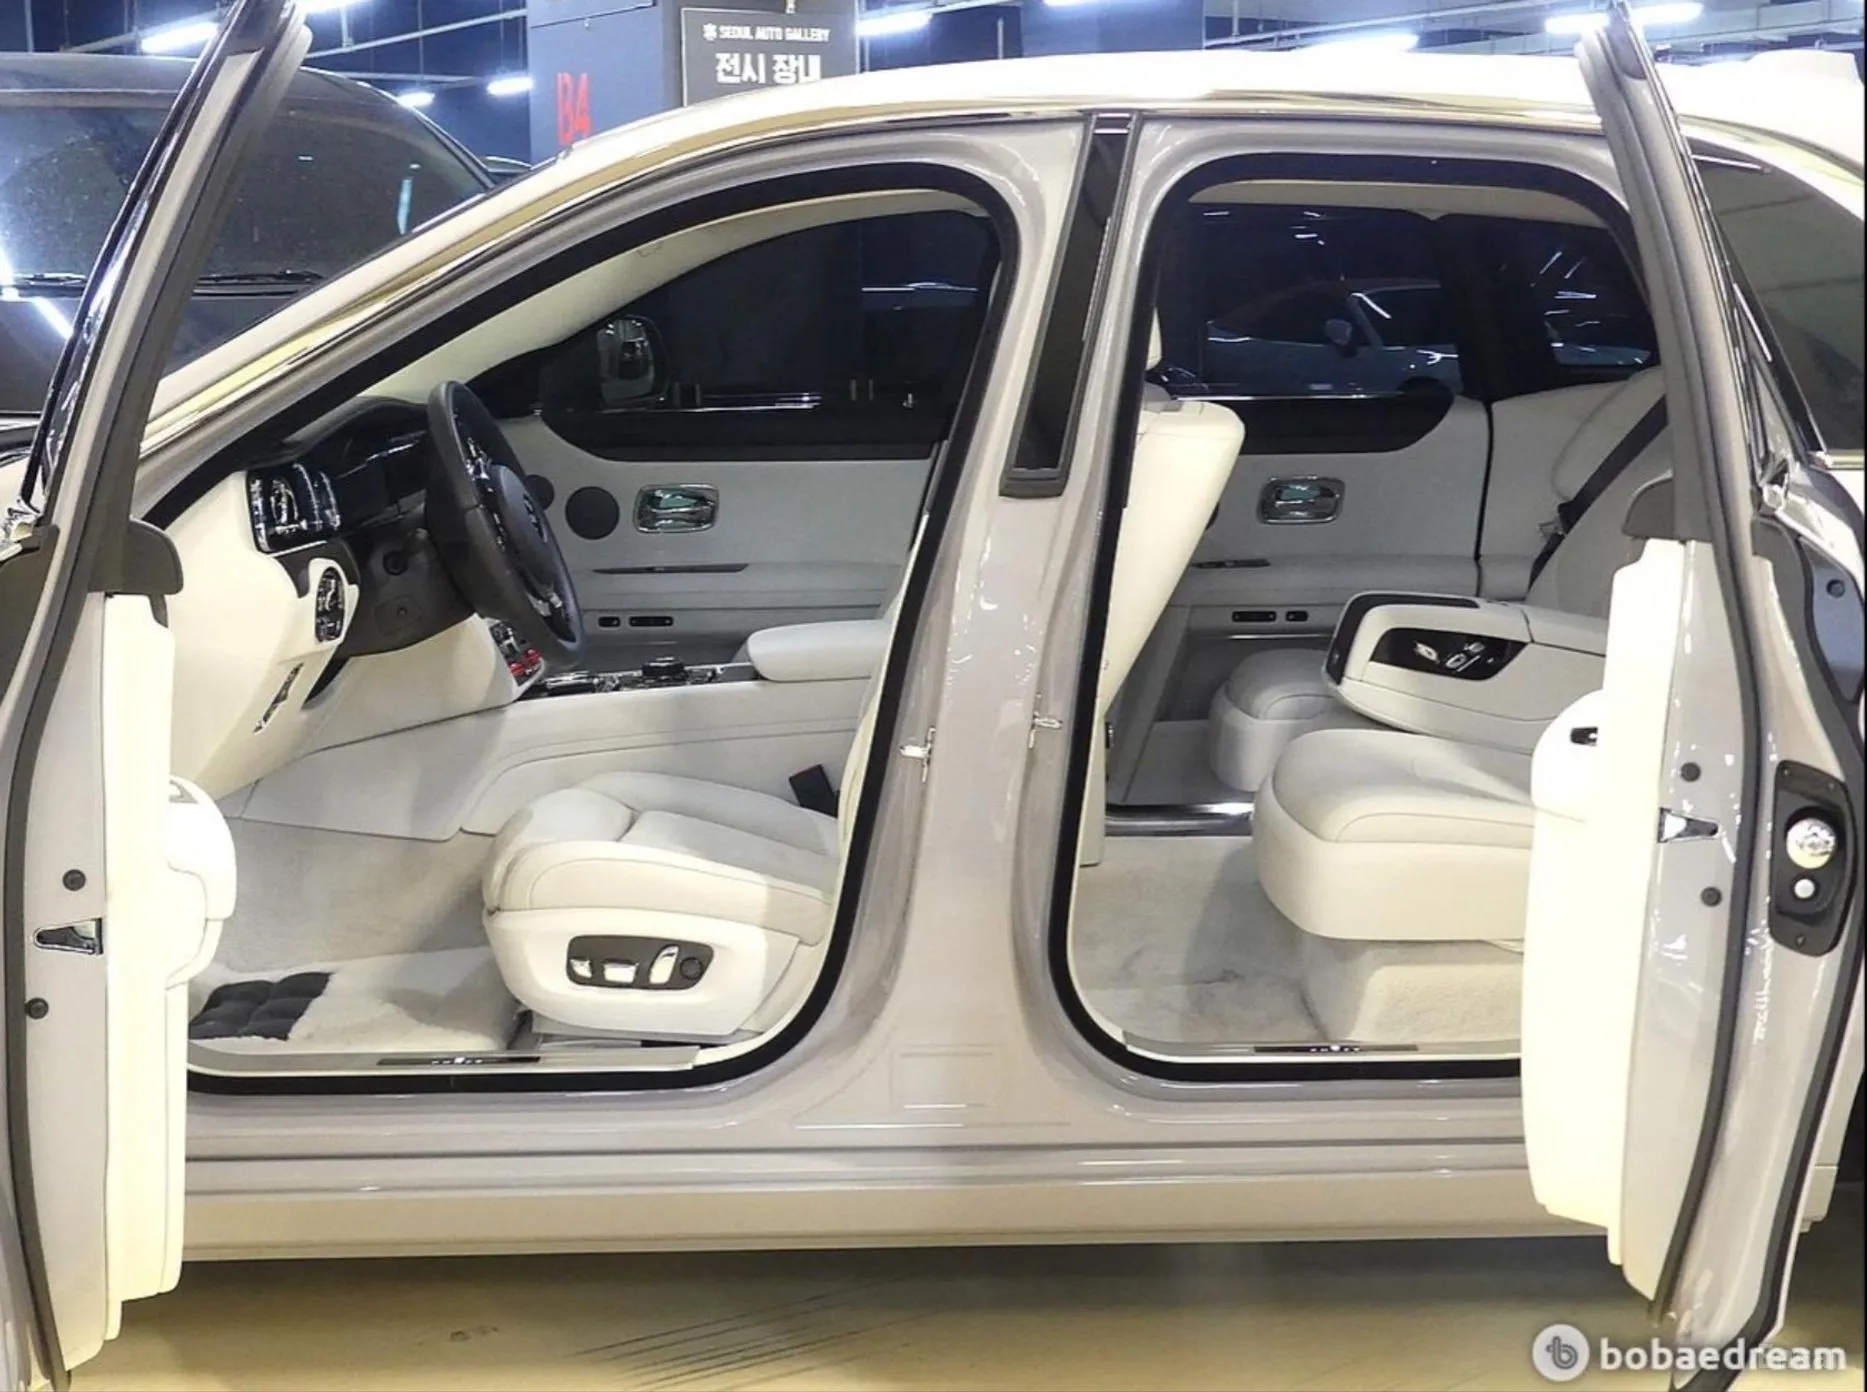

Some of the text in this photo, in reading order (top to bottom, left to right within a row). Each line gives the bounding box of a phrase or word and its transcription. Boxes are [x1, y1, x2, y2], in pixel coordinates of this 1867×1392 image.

[719, 25, 830, 42] SEOUL AUTO GALLERY
[715, 52, 766, 84] 전시
[556, 72, 592, 145] B4
